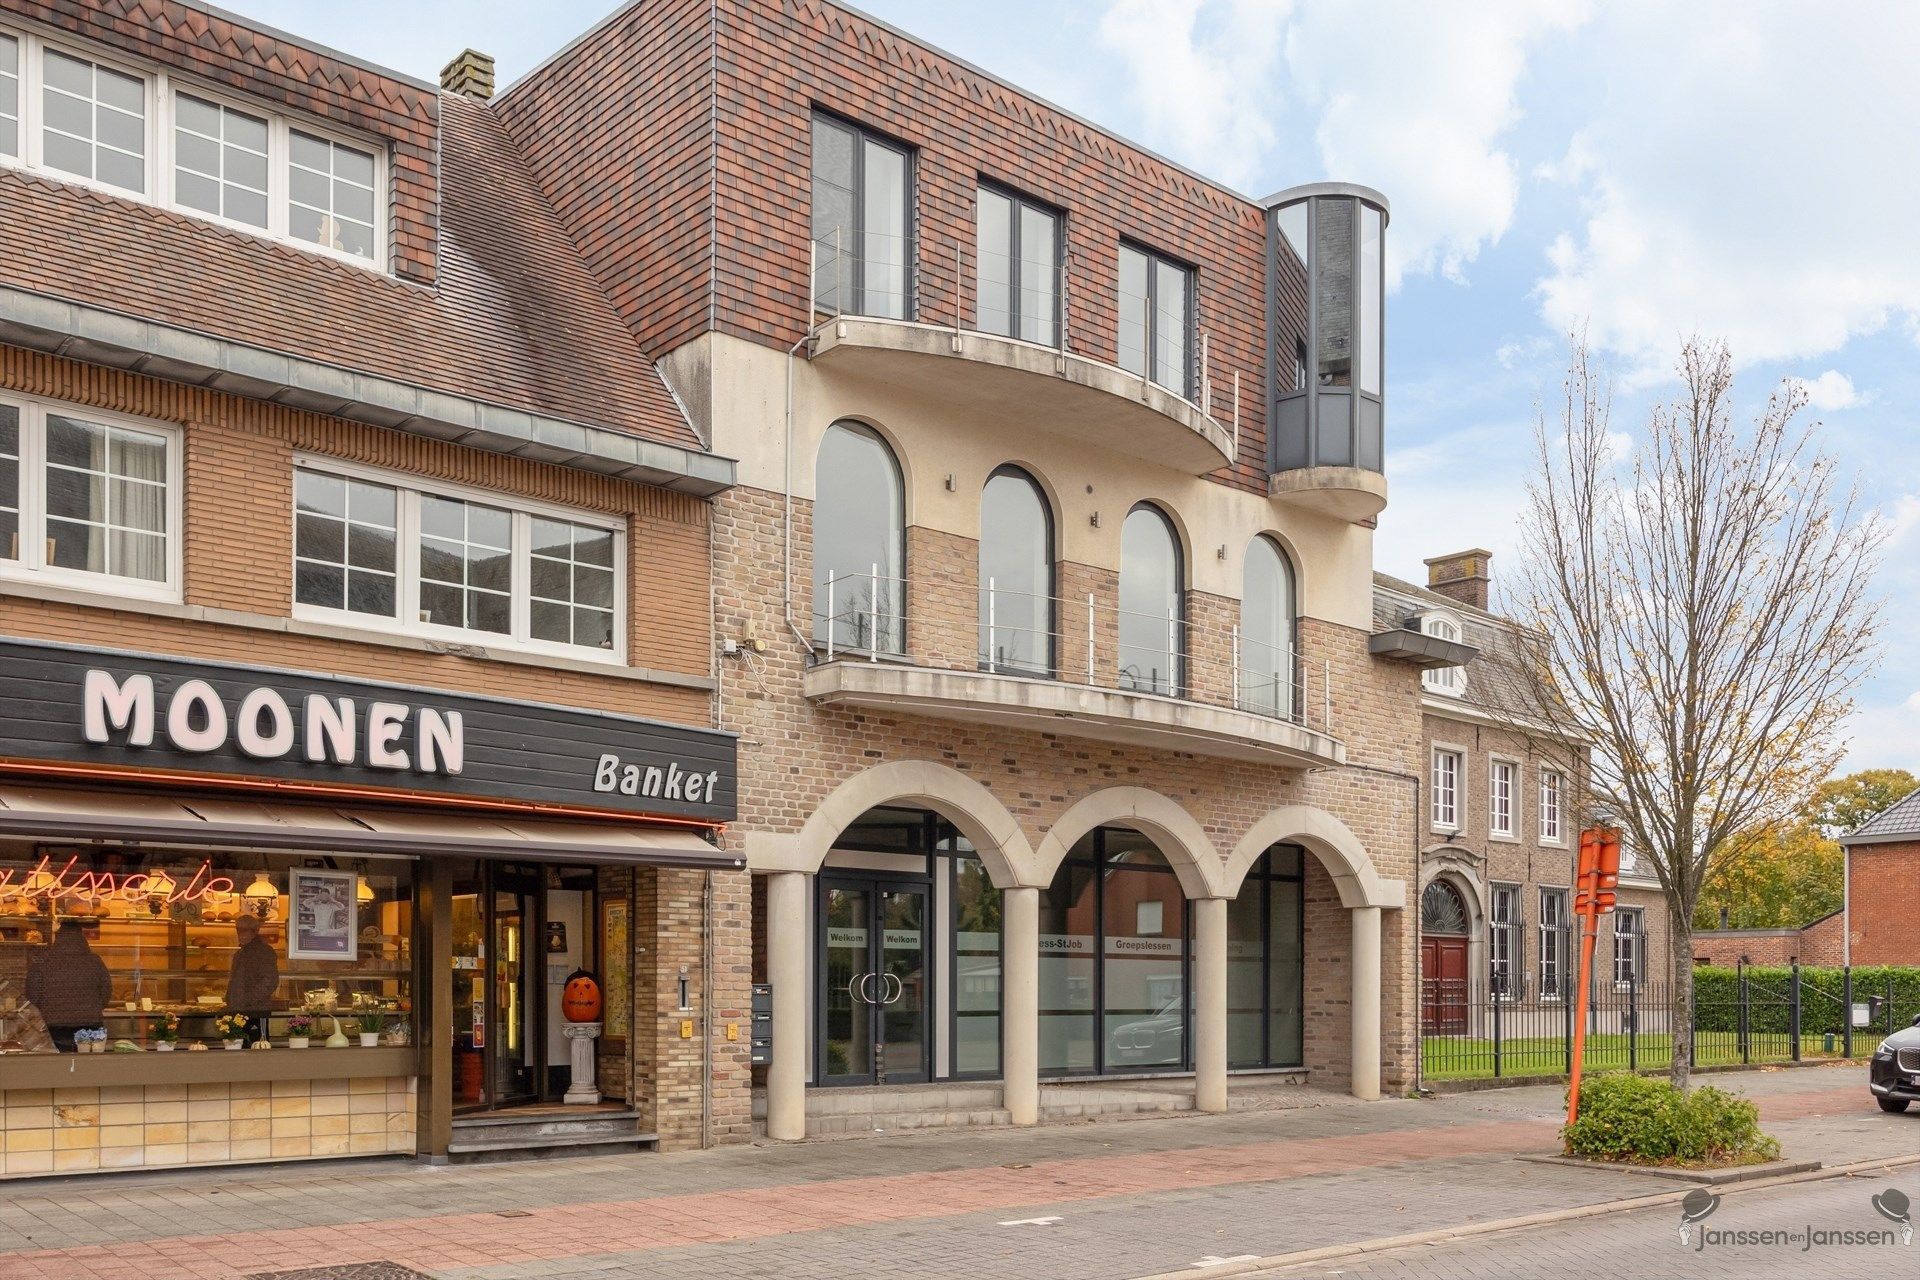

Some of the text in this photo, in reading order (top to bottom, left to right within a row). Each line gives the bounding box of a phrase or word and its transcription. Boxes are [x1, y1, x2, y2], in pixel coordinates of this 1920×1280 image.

[83, 669, 464, 775] MOONEN
[593, 753, 718, 803] Banket
[830, 933, 864, 942] Welkom
[886, 935, 918, 944] Welkom
[1115, 939, 1172, 951] Groepslessen
